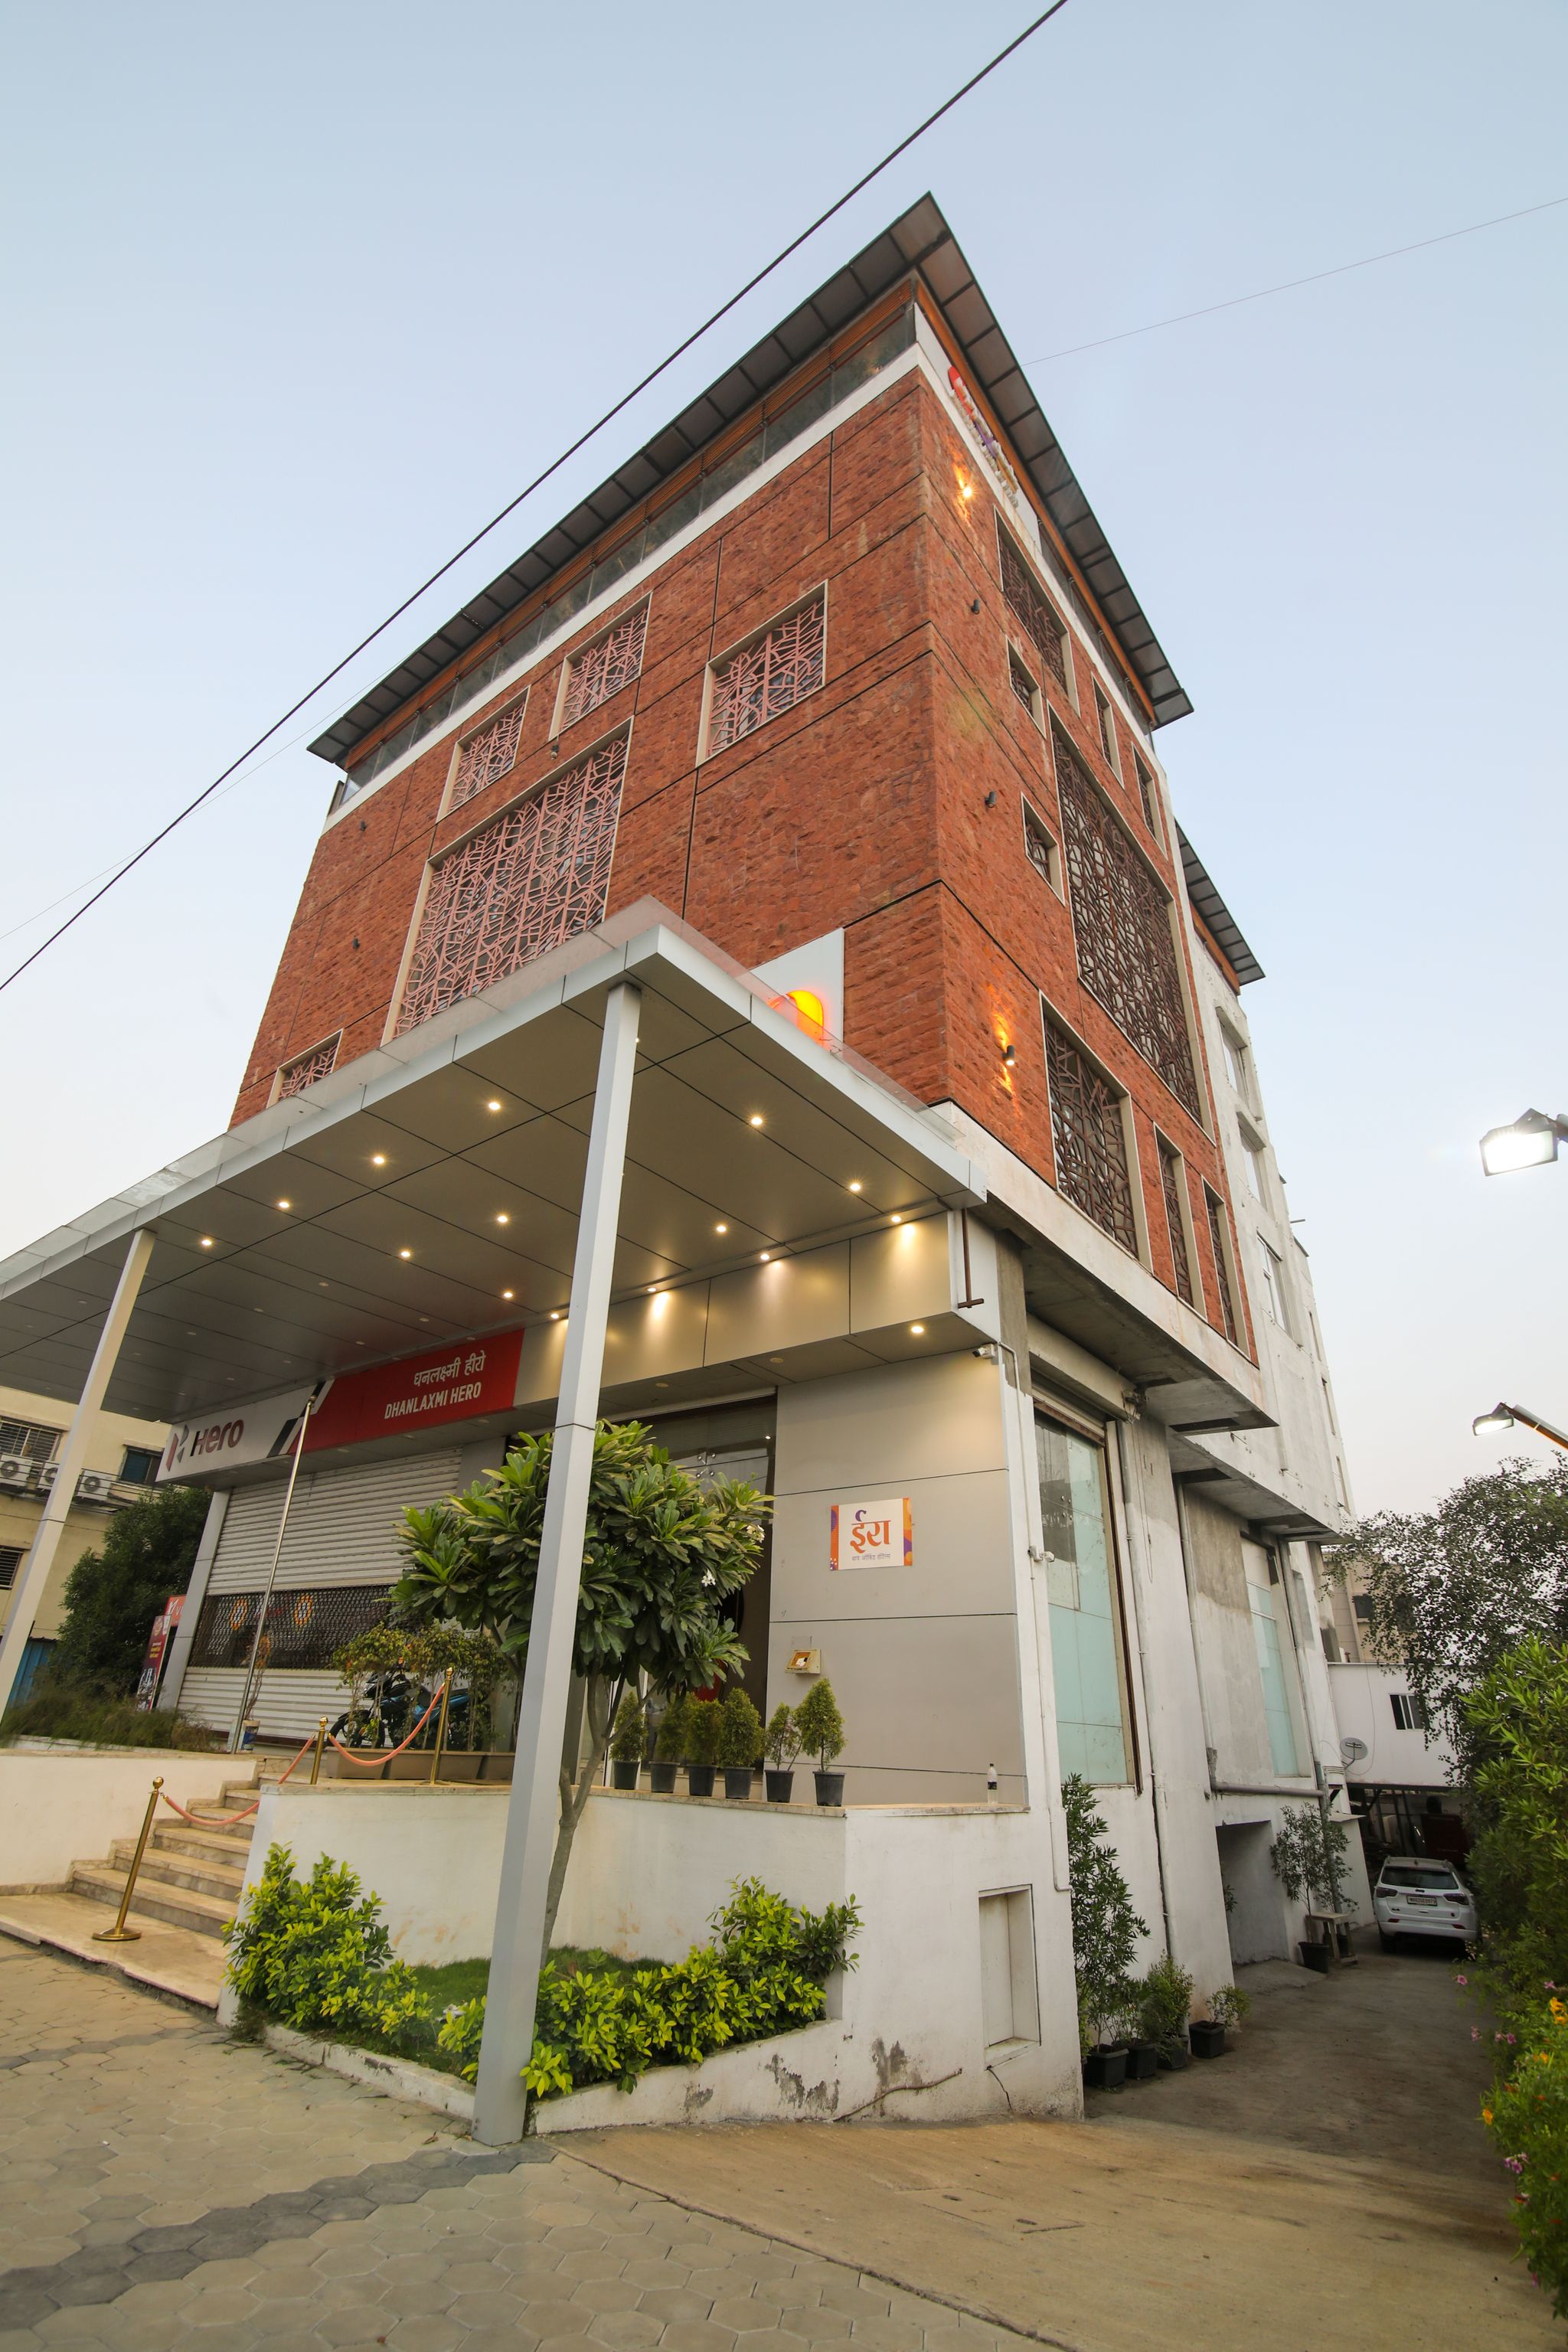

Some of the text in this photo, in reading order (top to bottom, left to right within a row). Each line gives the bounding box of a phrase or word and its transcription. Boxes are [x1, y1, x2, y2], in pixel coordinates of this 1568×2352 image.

[413, 1350, 486, 1387] धनलक्ष्मी हीरो
[384, 1381, 482, 1419] DHANLAXMI HERO
[190, 1419, 244, 1457] Hero
